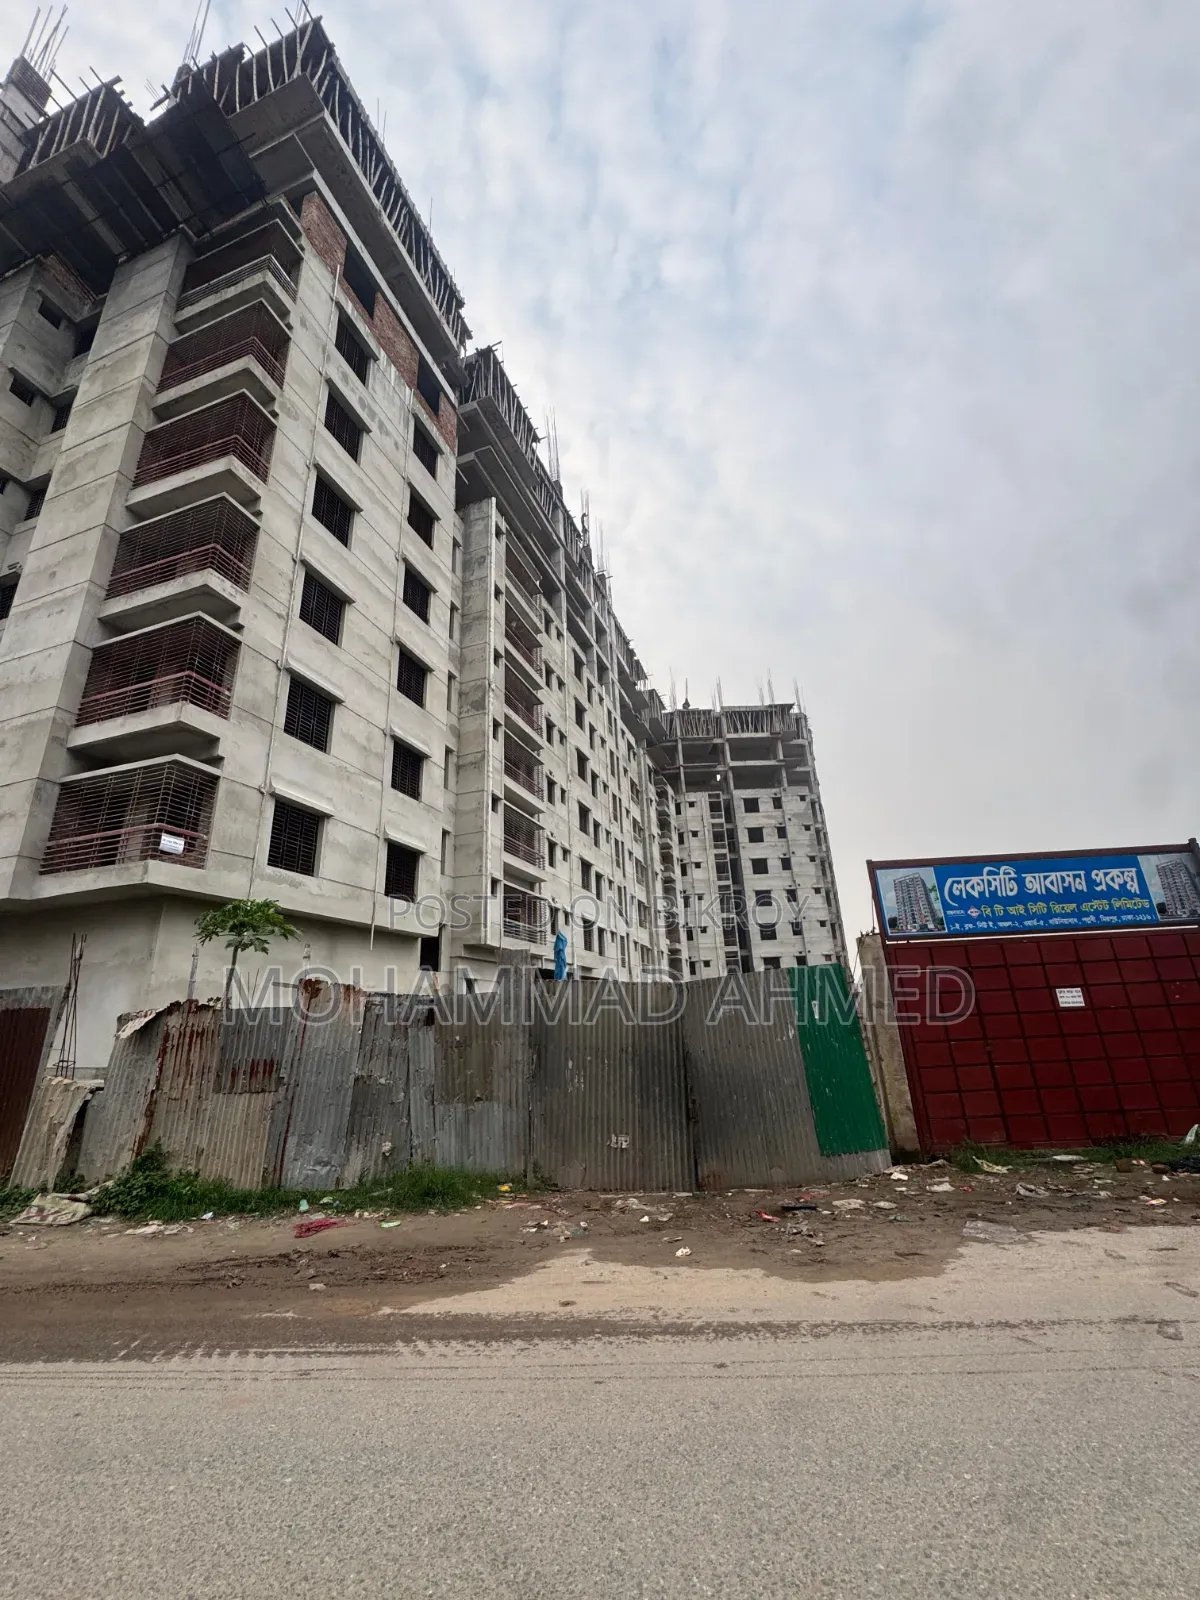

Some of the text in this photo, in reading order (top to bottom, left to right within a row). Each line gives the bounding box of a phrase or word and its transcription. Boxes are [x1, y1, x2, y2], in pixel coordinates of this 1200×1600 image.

[944, 865, 1140, 907] লেকসিটি আবাসন প্রকল্প
[981, 904, 992, 918] বি
[993, 903, 1005, 916] টি
[1006, 903, 1027, 916] আই
[1027, 901, 1048, 915] সিটি
[1049, 901, 1079, 914] রিয়েল
[1080, 898, 1109, 912] এস্টেট
[1111, 897, 1151, 911] লিমিটেড
